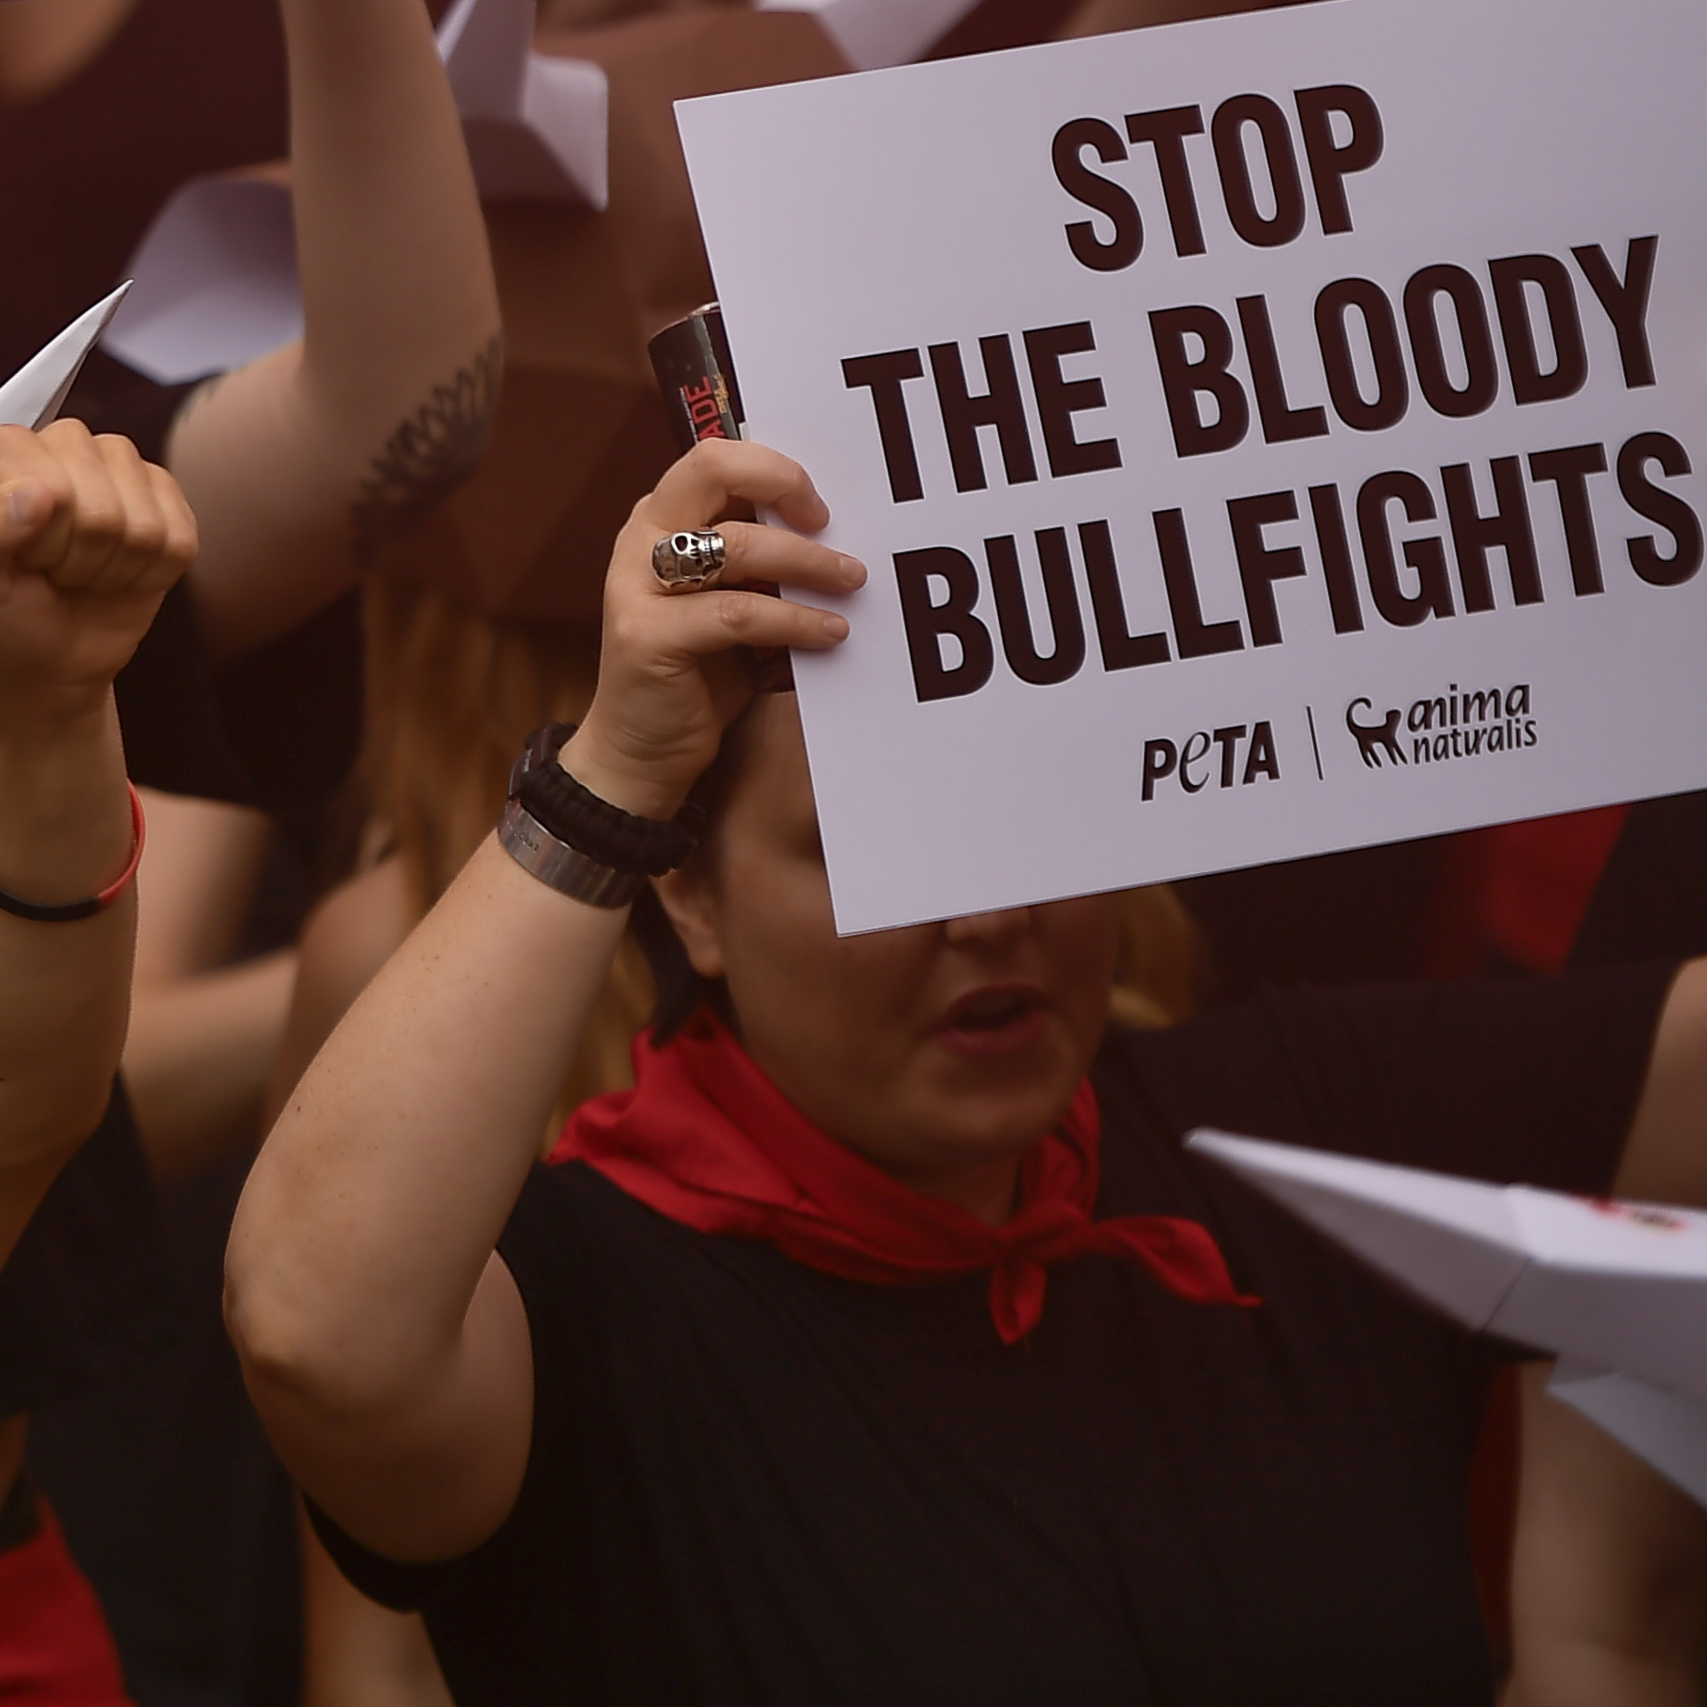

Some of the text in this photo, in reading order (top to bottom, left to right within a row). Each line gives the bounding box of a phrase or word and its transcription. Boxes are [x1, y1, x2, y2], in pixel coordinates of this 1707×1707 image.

[1052, 84, 1383, 271] STOP
[841, 235, 1658, 503] THE BLOODY
[893, 431, 1703, 702] BULLFIGHTS
[1407, 684, 1529, 732] anima
[1413, 720, 1537, 763] naturalis
